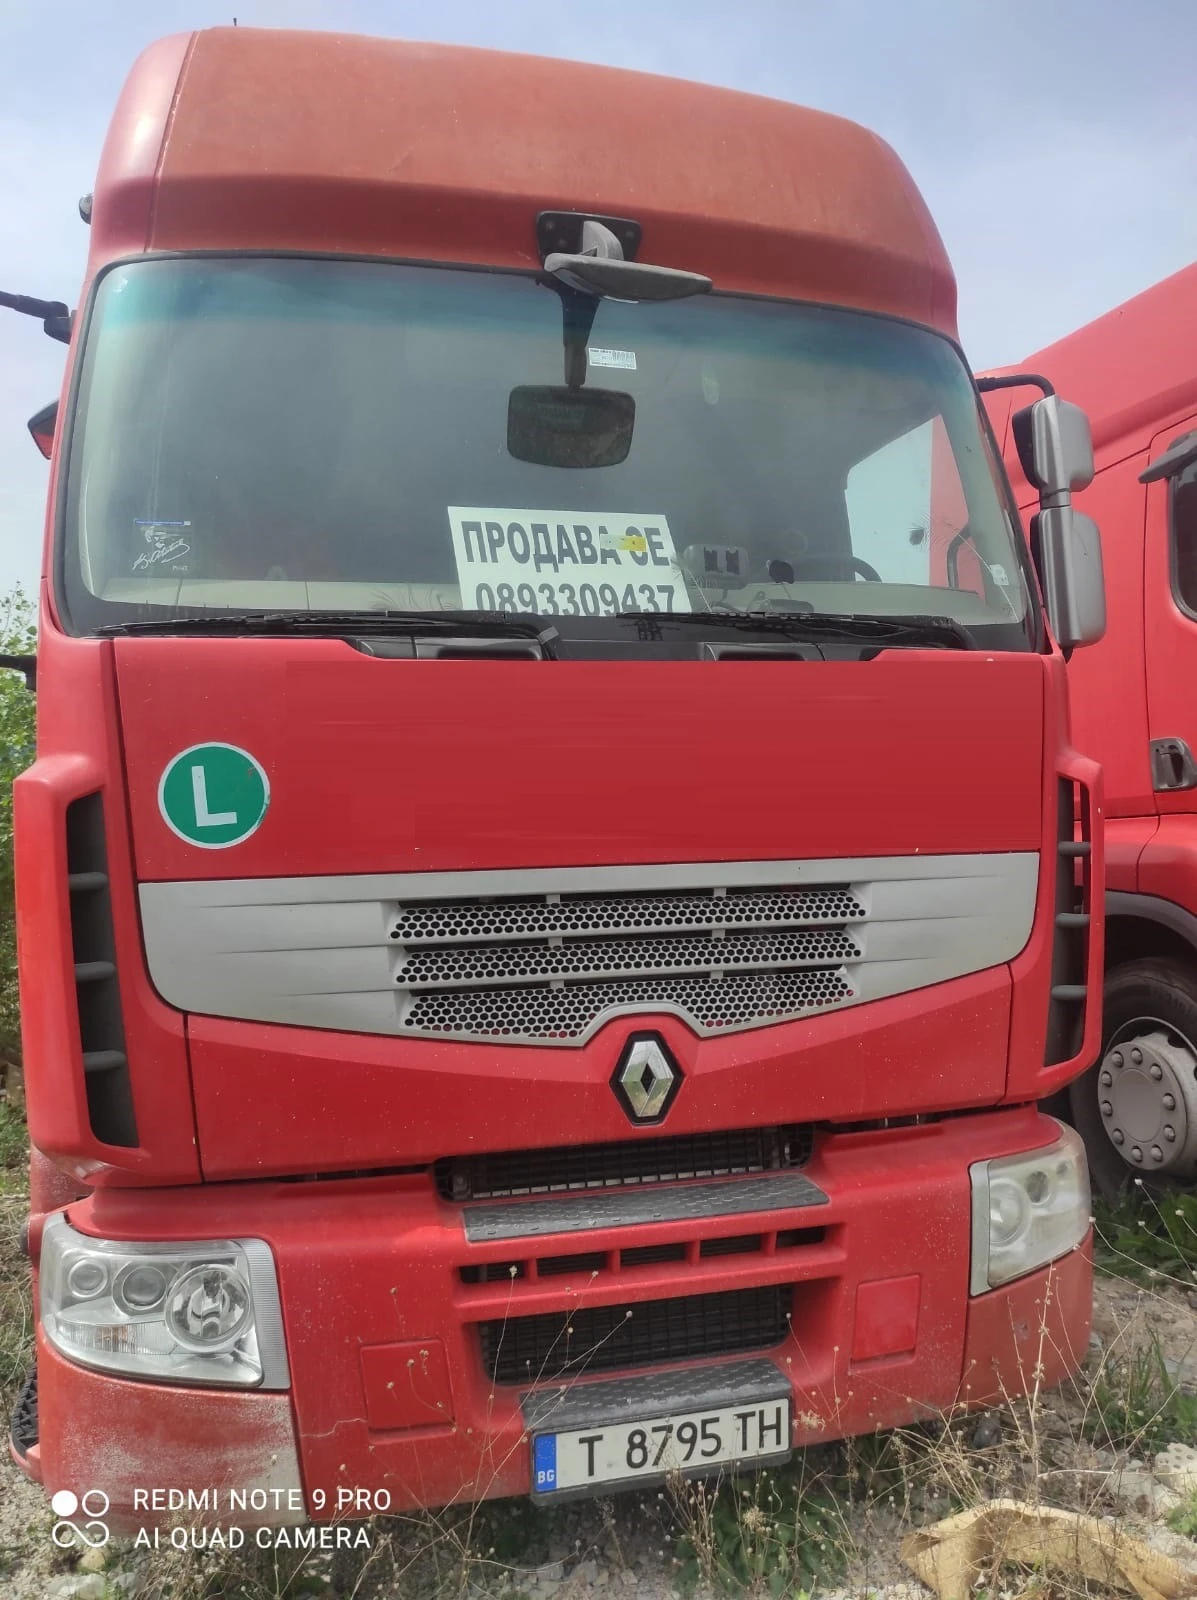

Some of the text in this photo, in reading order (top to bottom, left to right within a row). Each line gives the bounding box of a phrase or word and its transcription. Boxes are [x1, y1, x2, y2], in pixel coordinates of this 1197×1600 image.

[461, 521, 622, 573] ПРОДАВА
[475, 582, 675, 616] 0893309437
[191, 765, 238, 827] L
[578, 1406, 782, 1477] T 8795 TH
[537, 1469, 555, 1484] BG
